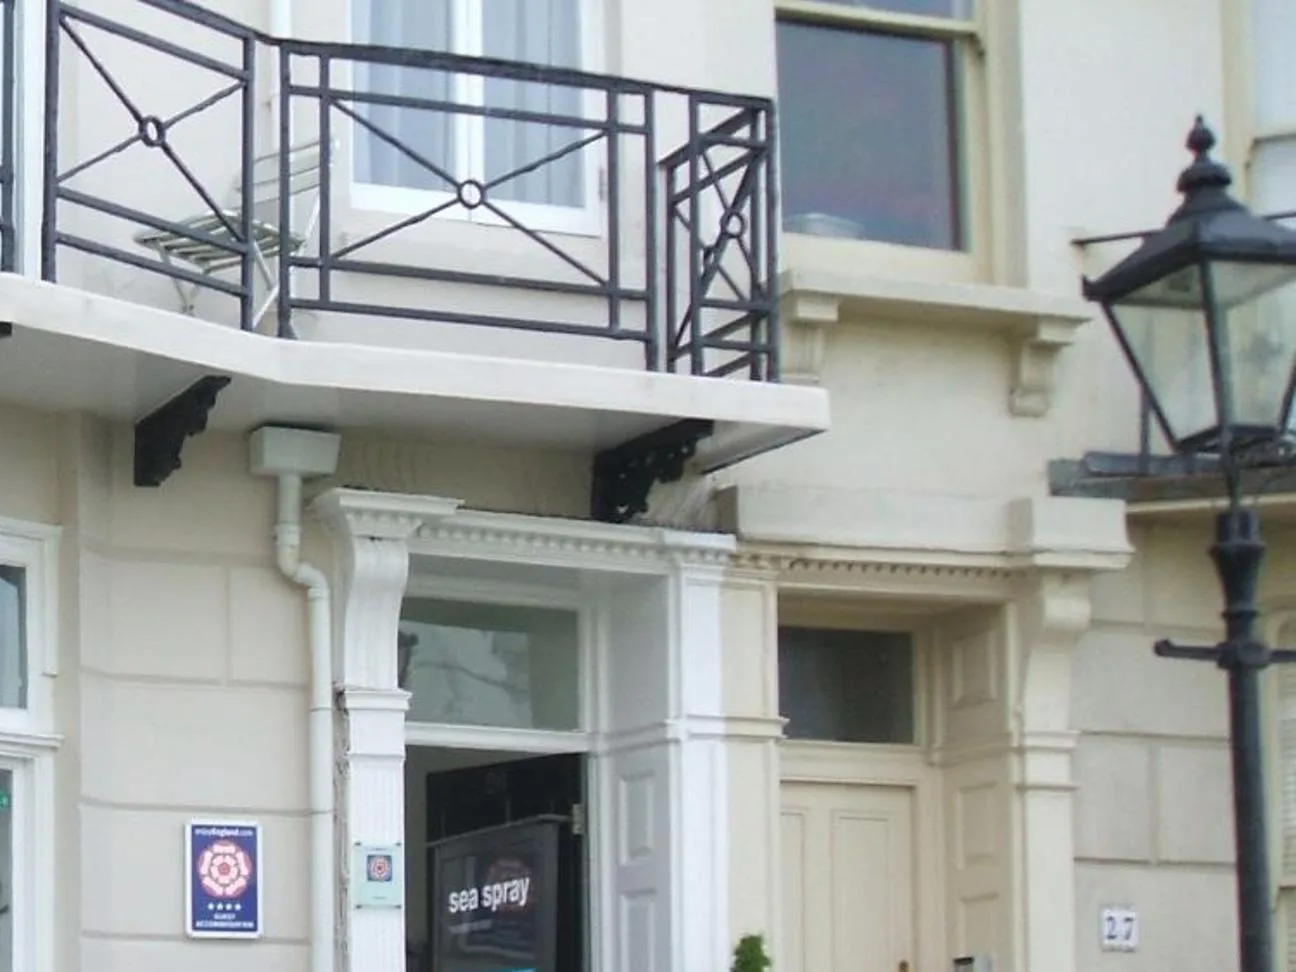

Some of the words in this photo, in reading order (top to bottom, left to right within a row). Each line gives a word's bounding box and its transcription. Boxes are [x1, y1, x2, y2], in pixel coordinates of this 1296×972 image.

[449, 888, 479, 913] sea
[482, 877, 530, 912] spray
[1105, 915, 1134, 941] 27
